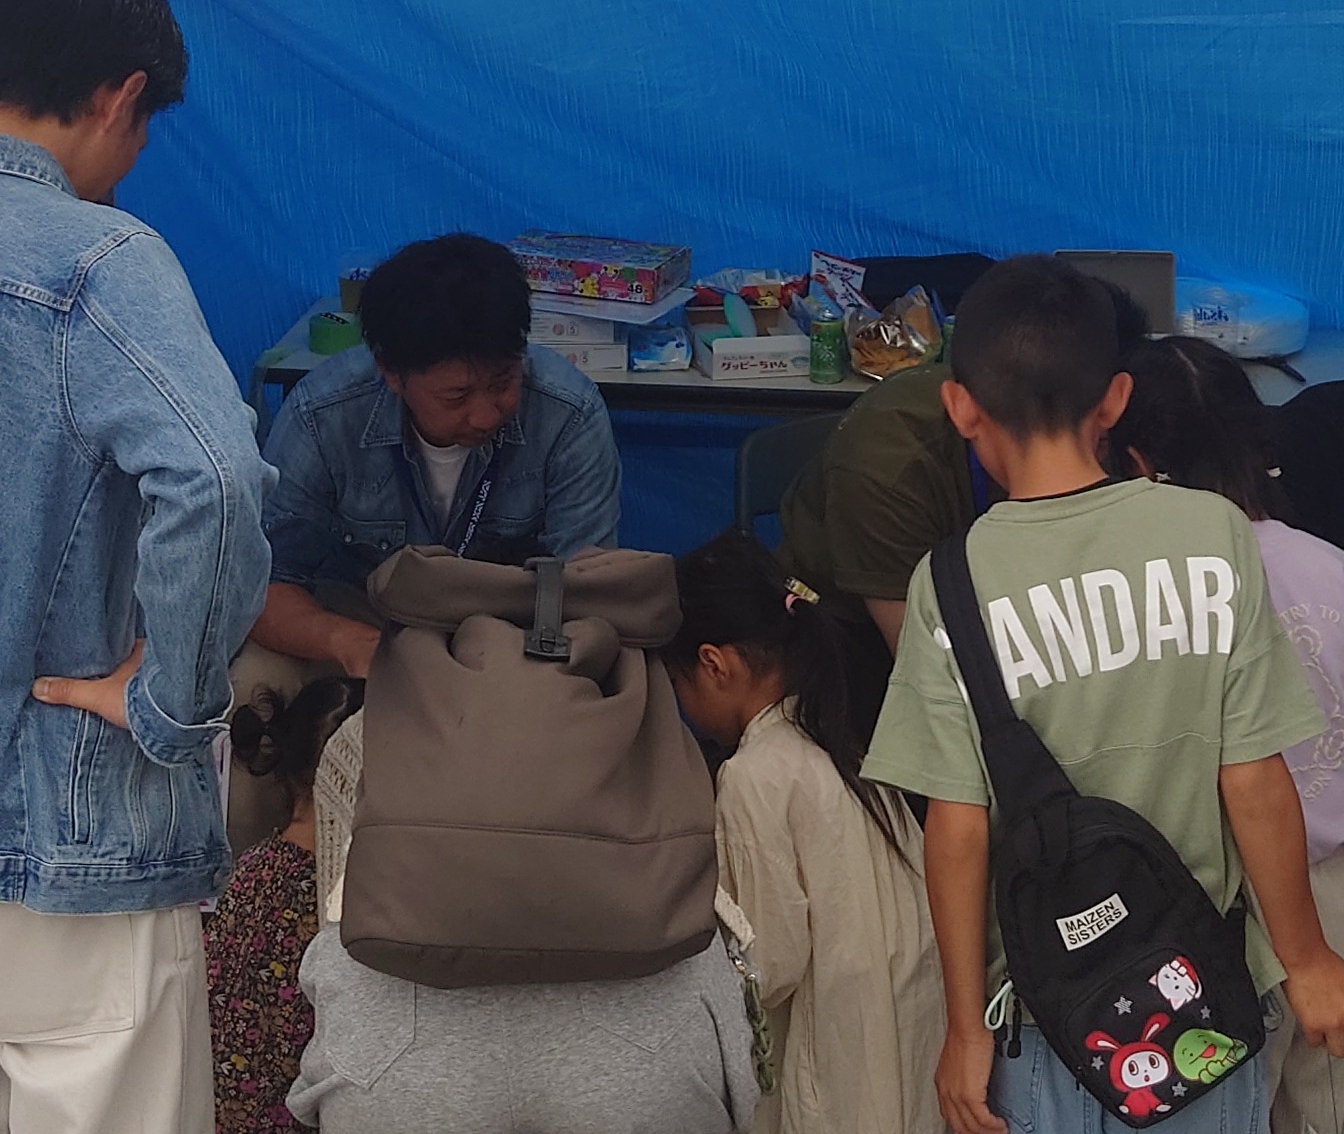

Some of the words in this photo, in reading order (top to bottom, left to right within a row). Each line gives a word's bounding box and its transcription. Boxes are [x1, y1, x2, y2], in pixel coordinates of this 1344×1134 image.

[933, 556, 1241, 706] ANDAR
[1064, 901, 1115, 933] MAIZEN
[1067, 908, 1123, 945] SISTERS
